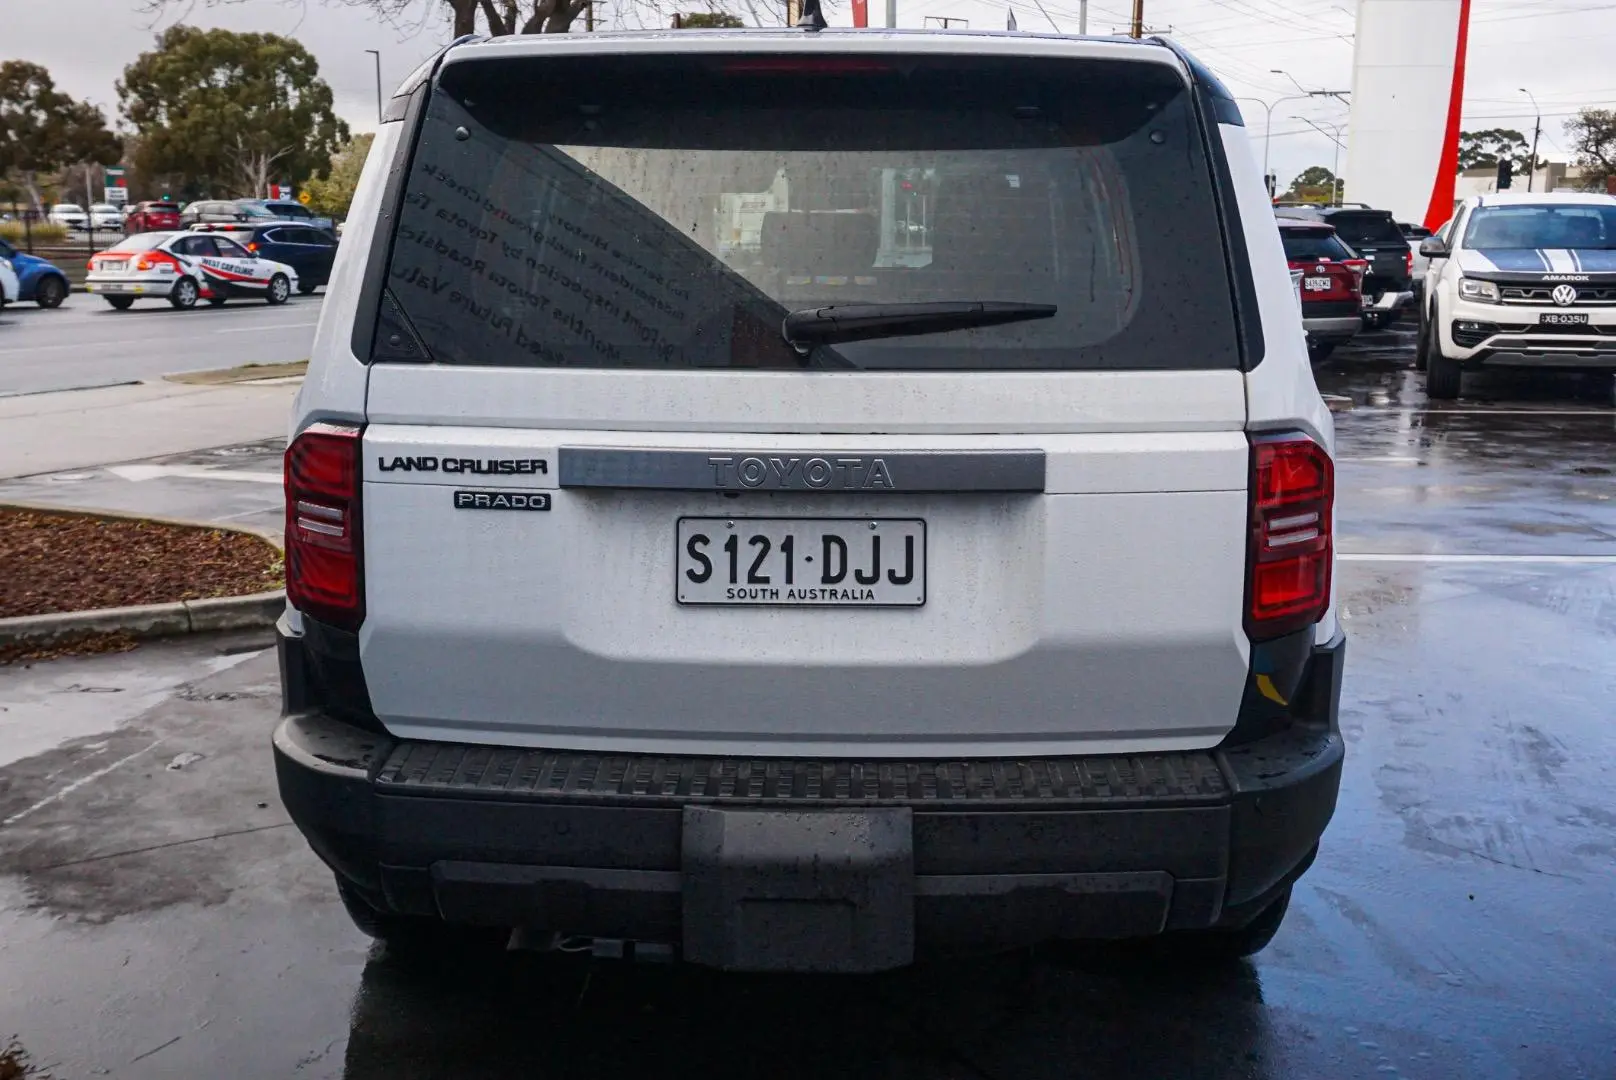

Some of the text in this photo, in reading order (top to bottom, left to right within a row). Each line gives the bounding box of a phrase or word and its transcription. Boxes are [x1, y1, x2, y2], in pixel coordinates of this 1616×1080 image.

[201, 257, 221, 269] WEST
[221, 262, 234, 272] CAR
[234, 265, 255, 276] CLINIC
[378, 456, 549, 475] LAND CRUISER
[708, 457, 896, 489] TOYOTA
[457, 493, 546, 509] PRADO
[726, 588, 875, 600] SOUTH AUSTRALIA
